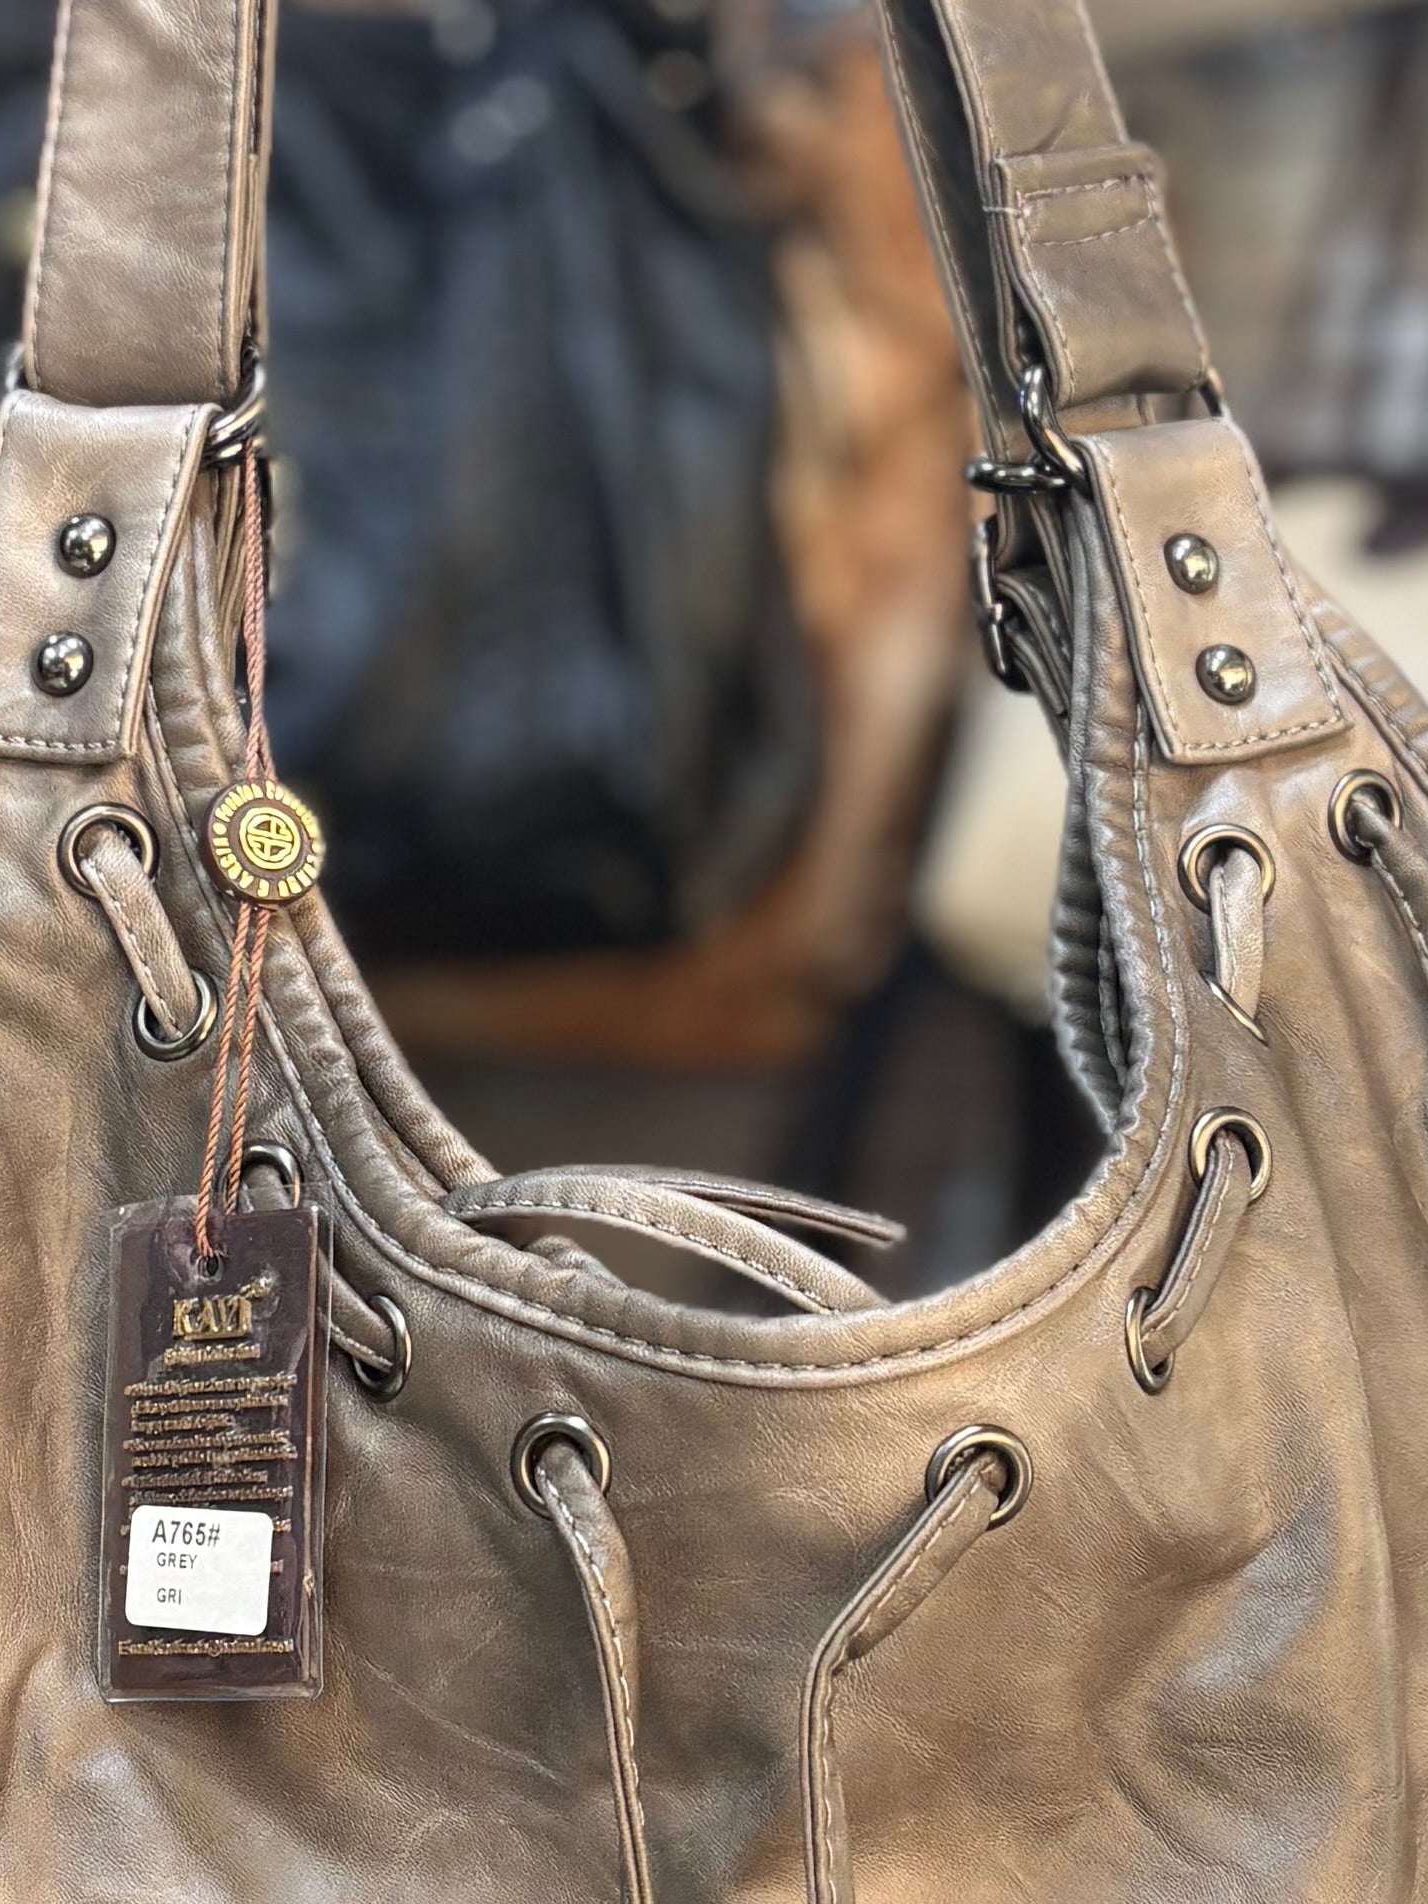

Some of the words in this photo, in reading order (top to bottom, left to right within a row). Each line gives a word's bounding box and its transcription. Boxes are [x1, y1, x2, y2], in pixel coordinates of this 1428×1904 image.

[152, 1519, 221, 1547] A765#
[156, 1552, 198, 1569] GREY
[156, 1587, 182, 1605] GRI
